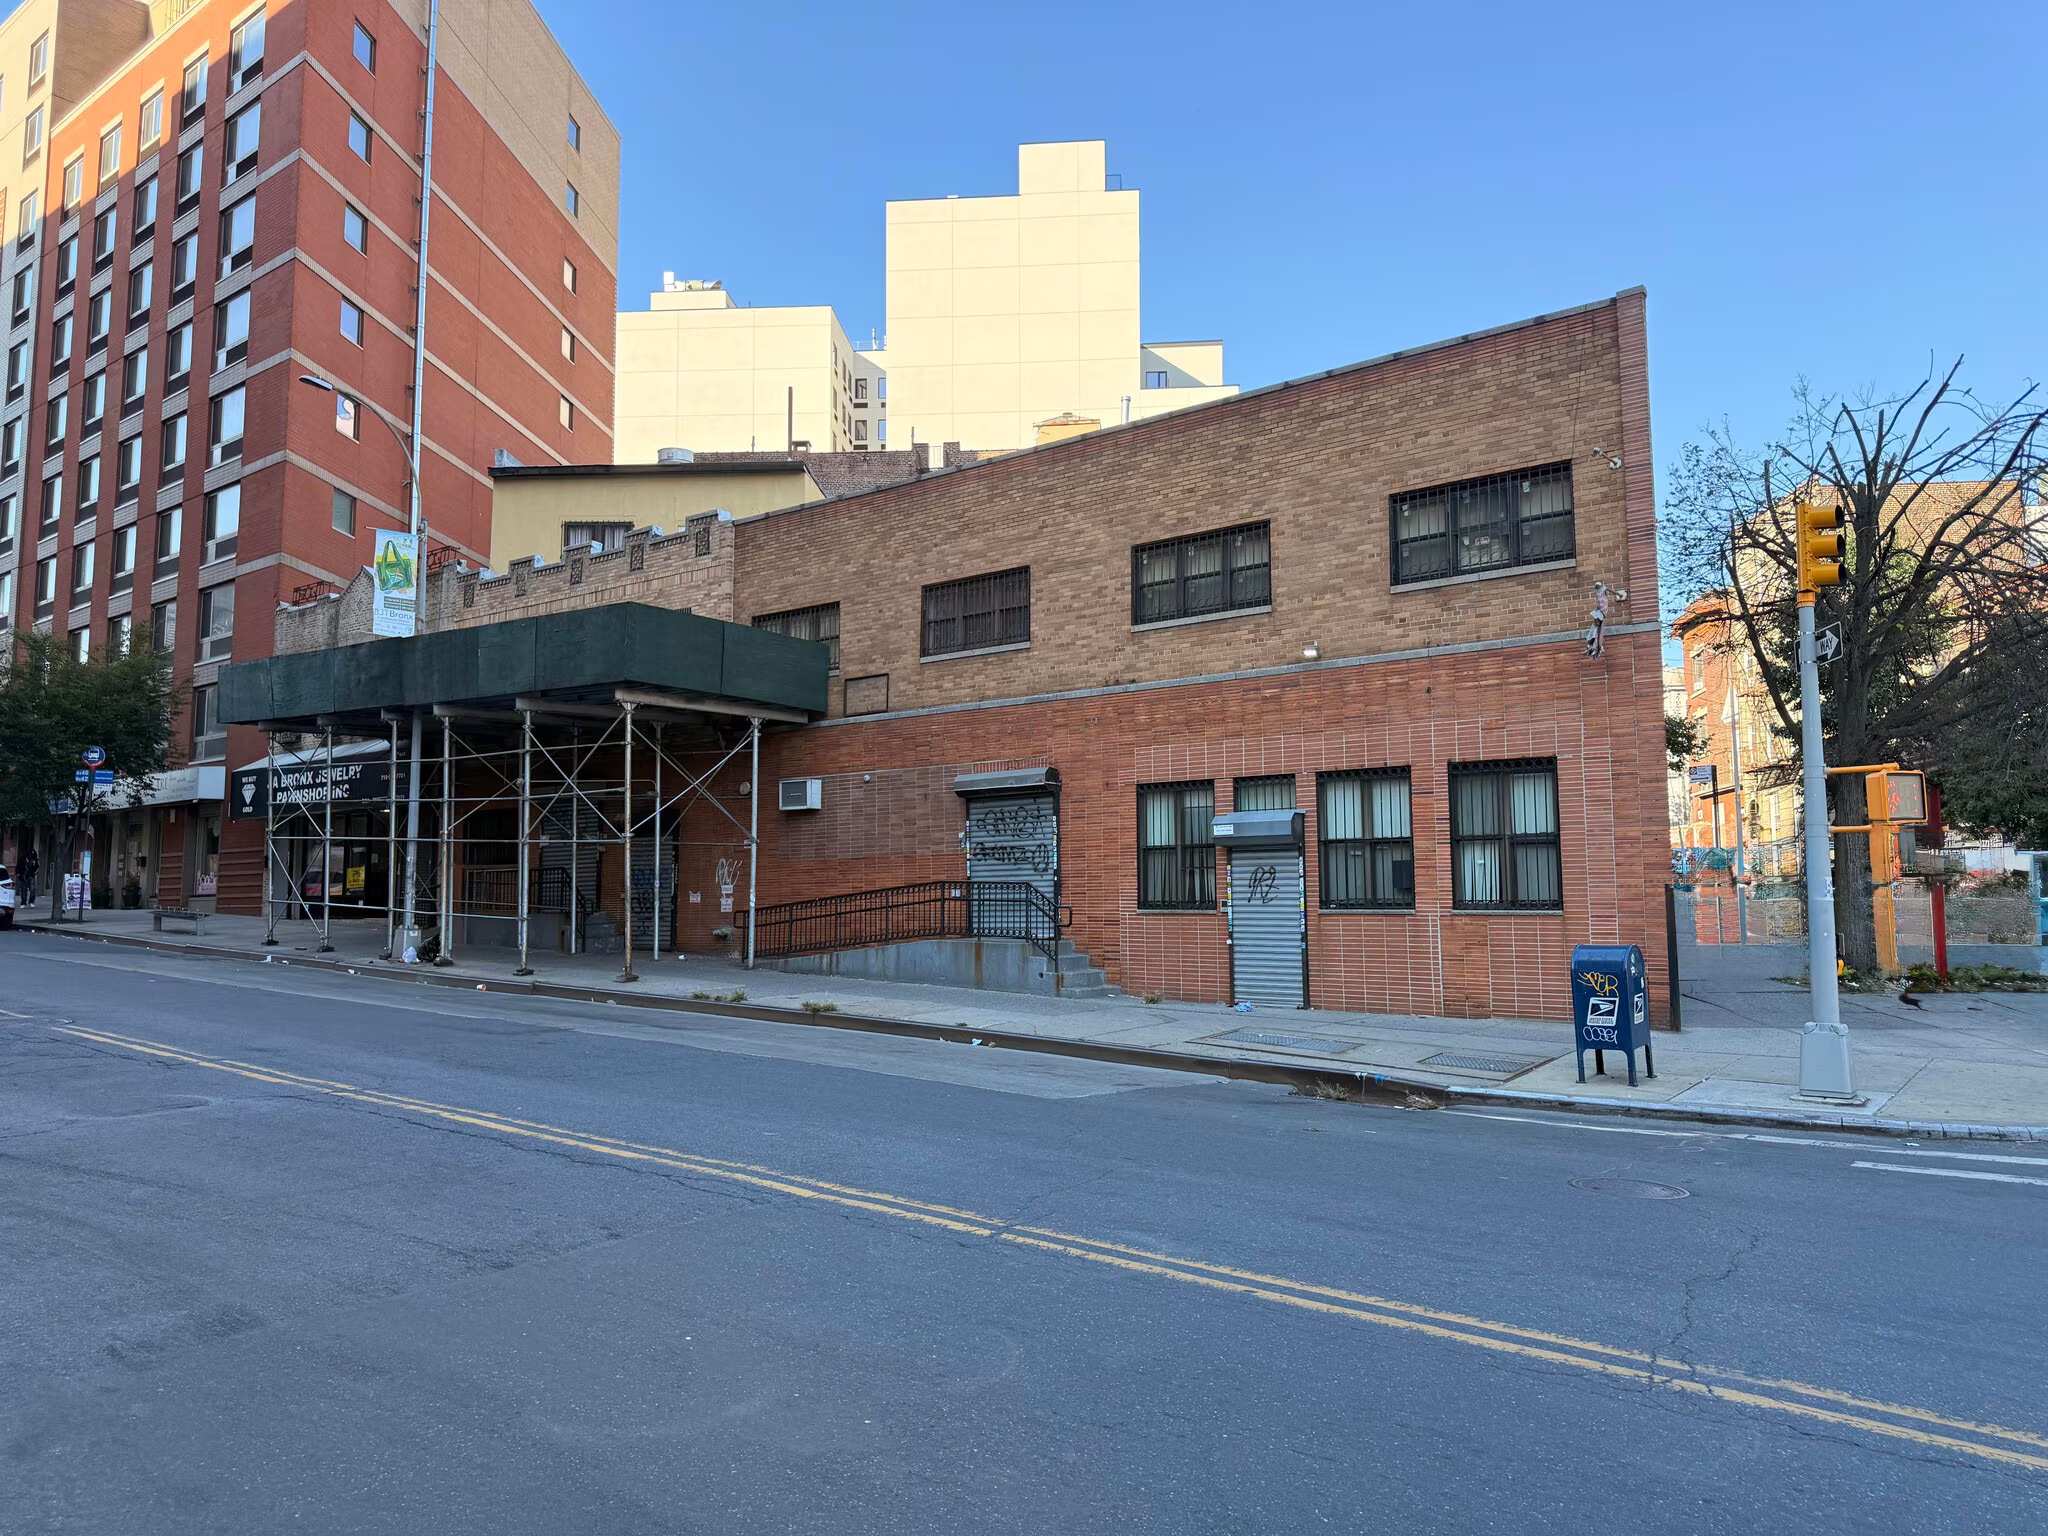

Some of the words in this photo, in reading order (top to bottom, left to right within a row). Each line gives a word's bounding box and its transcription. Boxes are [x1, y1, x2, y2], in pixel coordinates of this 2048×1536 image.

[1820, 636, 1834, 653] WAY
[281, 771, 314, 788] BRONX
[332, 784, 350, 799] INC
